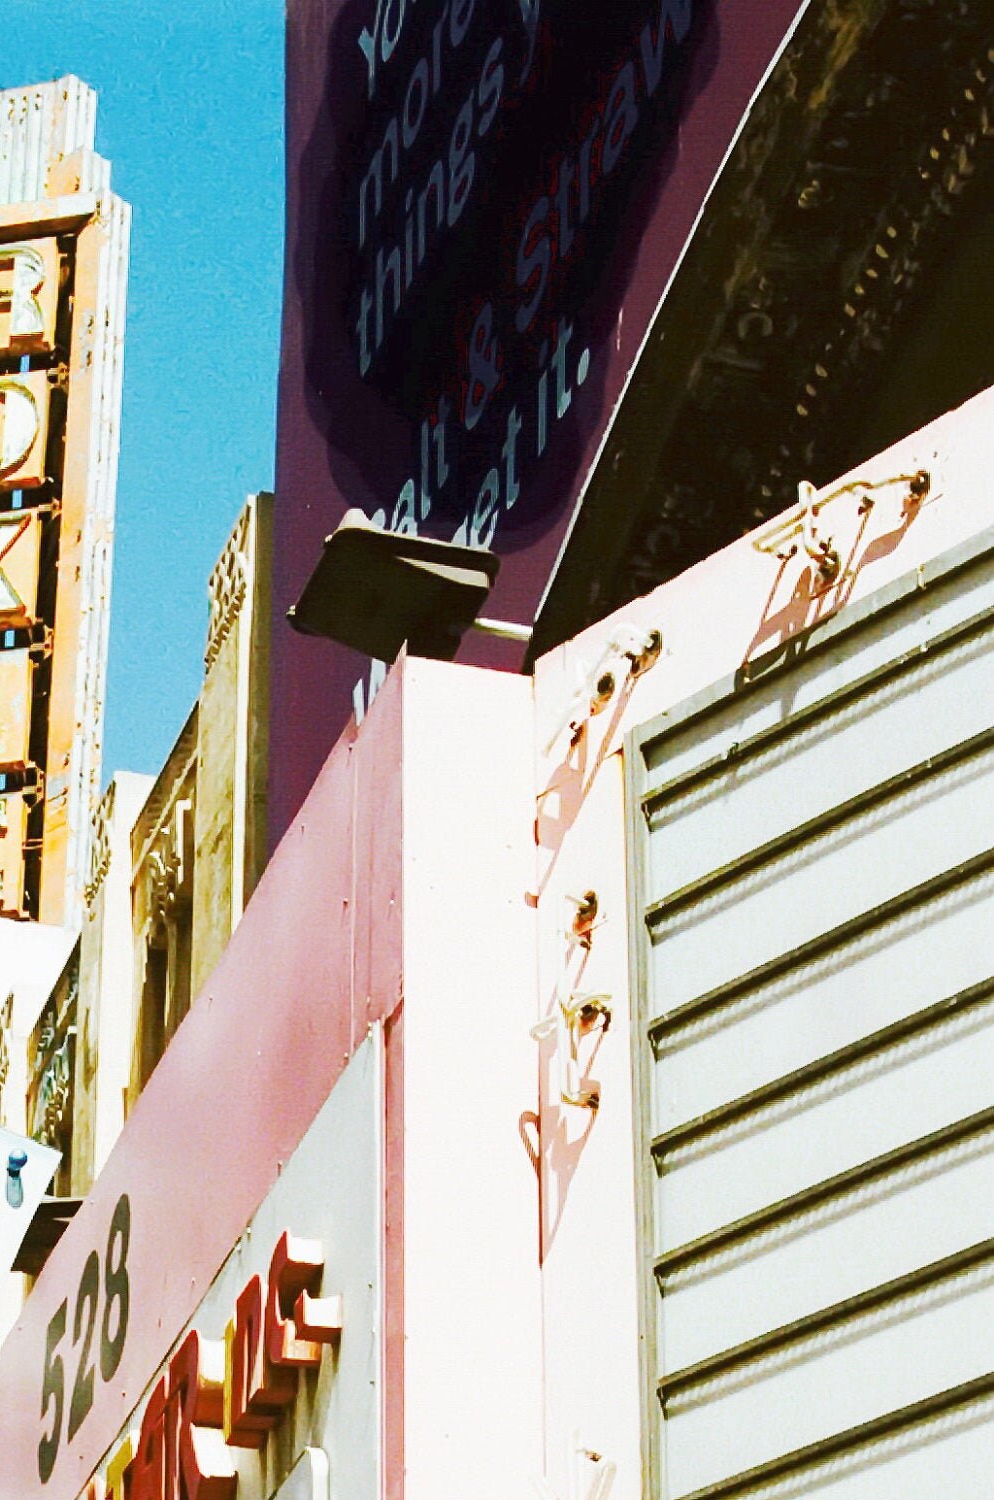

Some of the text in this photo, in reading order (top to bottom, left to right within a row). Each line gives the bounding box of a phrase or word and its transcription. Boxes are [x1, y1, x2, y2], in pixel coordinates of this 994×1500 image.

[356, 37, 503, 372] things
[372, 0, 692, 537] alt & Straw
[452, 317, 590, 550] et it.
[39, 1194, 130, 1484] 528
